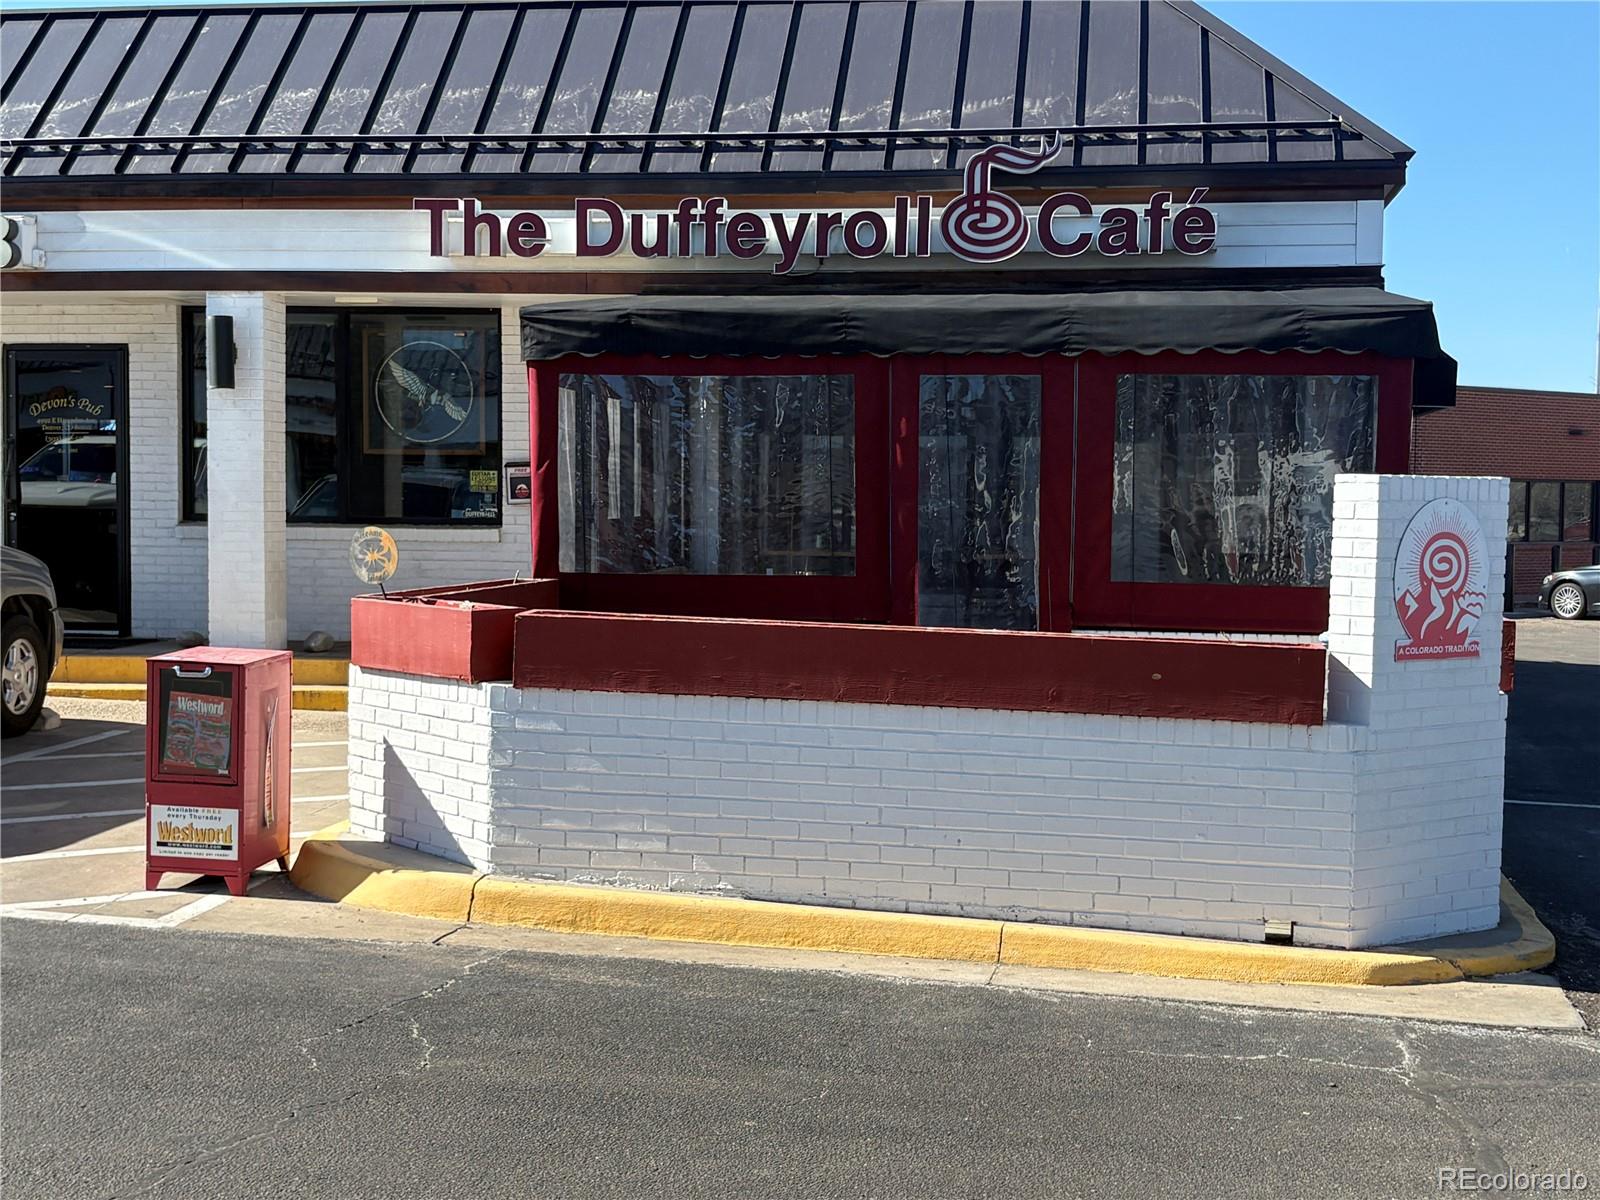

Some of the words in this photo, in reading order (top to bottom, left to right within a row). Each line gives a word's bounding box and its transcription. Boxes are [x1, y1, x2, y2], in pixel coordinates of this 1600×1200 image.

[413, 196, 552, 258] The
[573, 195, 932, 276] Duffeyroll
[1037, 186, 1218, 258] Café
[29, 396, 76, 416] Devon's
[77, 398, 104, 416] Pub
[1399, 647, 1404, 655] A
[1405, 645, 1444, 655] COLORADO
[1445, 644, 1480, 653] TRADITION
[177, 696, 224, 715] Westword
[167, 806, 199, 814] Available
[189, 813, 222, 822] Thursday
[157, 820, 233, 844] Westword
